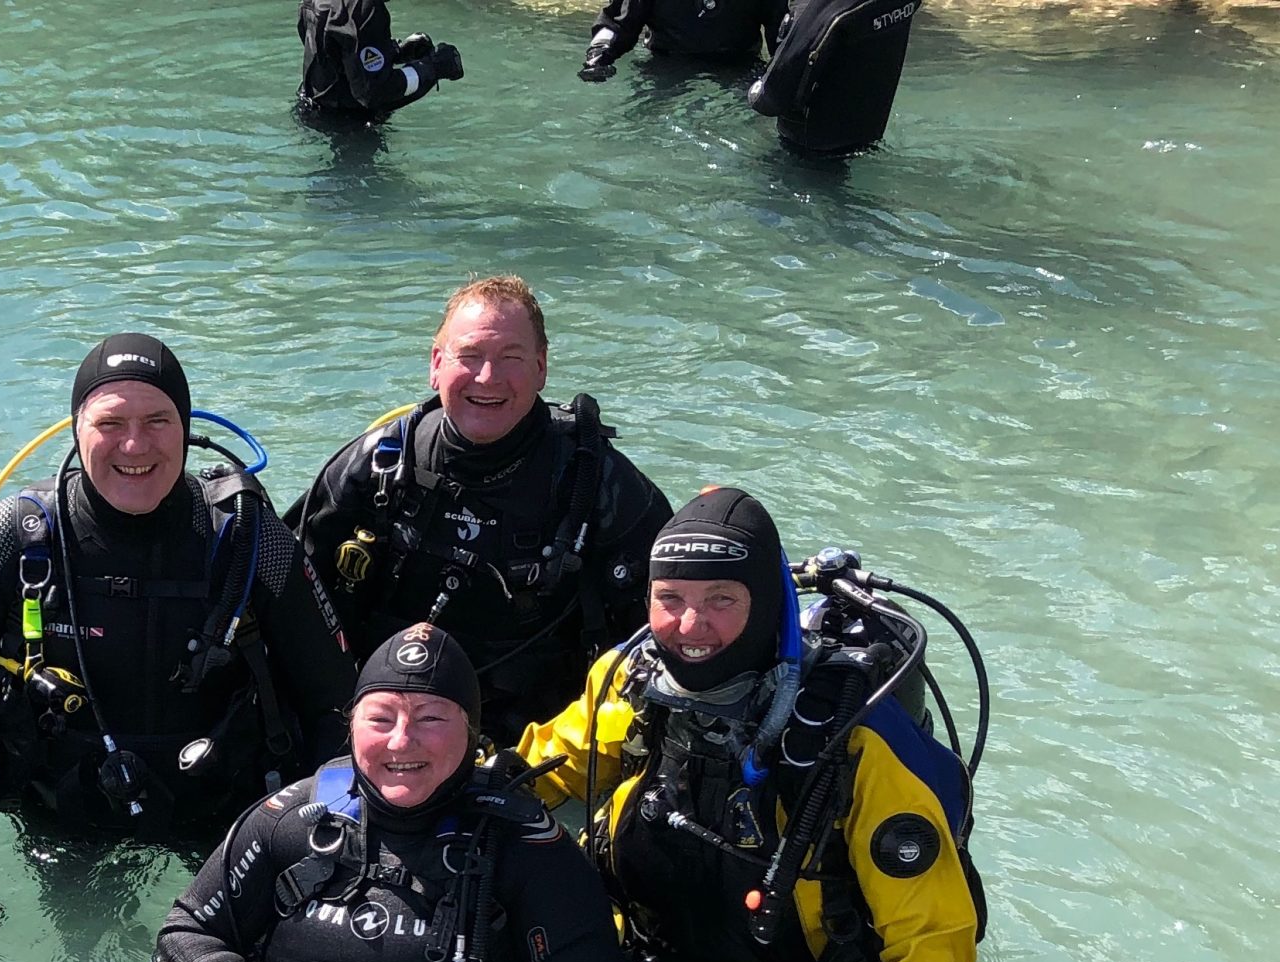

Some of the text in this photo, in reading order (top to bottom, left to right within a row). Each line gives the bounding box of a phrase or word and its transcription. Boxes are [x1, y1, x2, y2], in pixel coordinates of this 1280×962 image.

[444, 512, 497, 526] SCUBAPO
[45, 621, 84, 634] mars
[234, 840, 262, 880] LUNG
[305, 899, 426, 937] QUA LU
